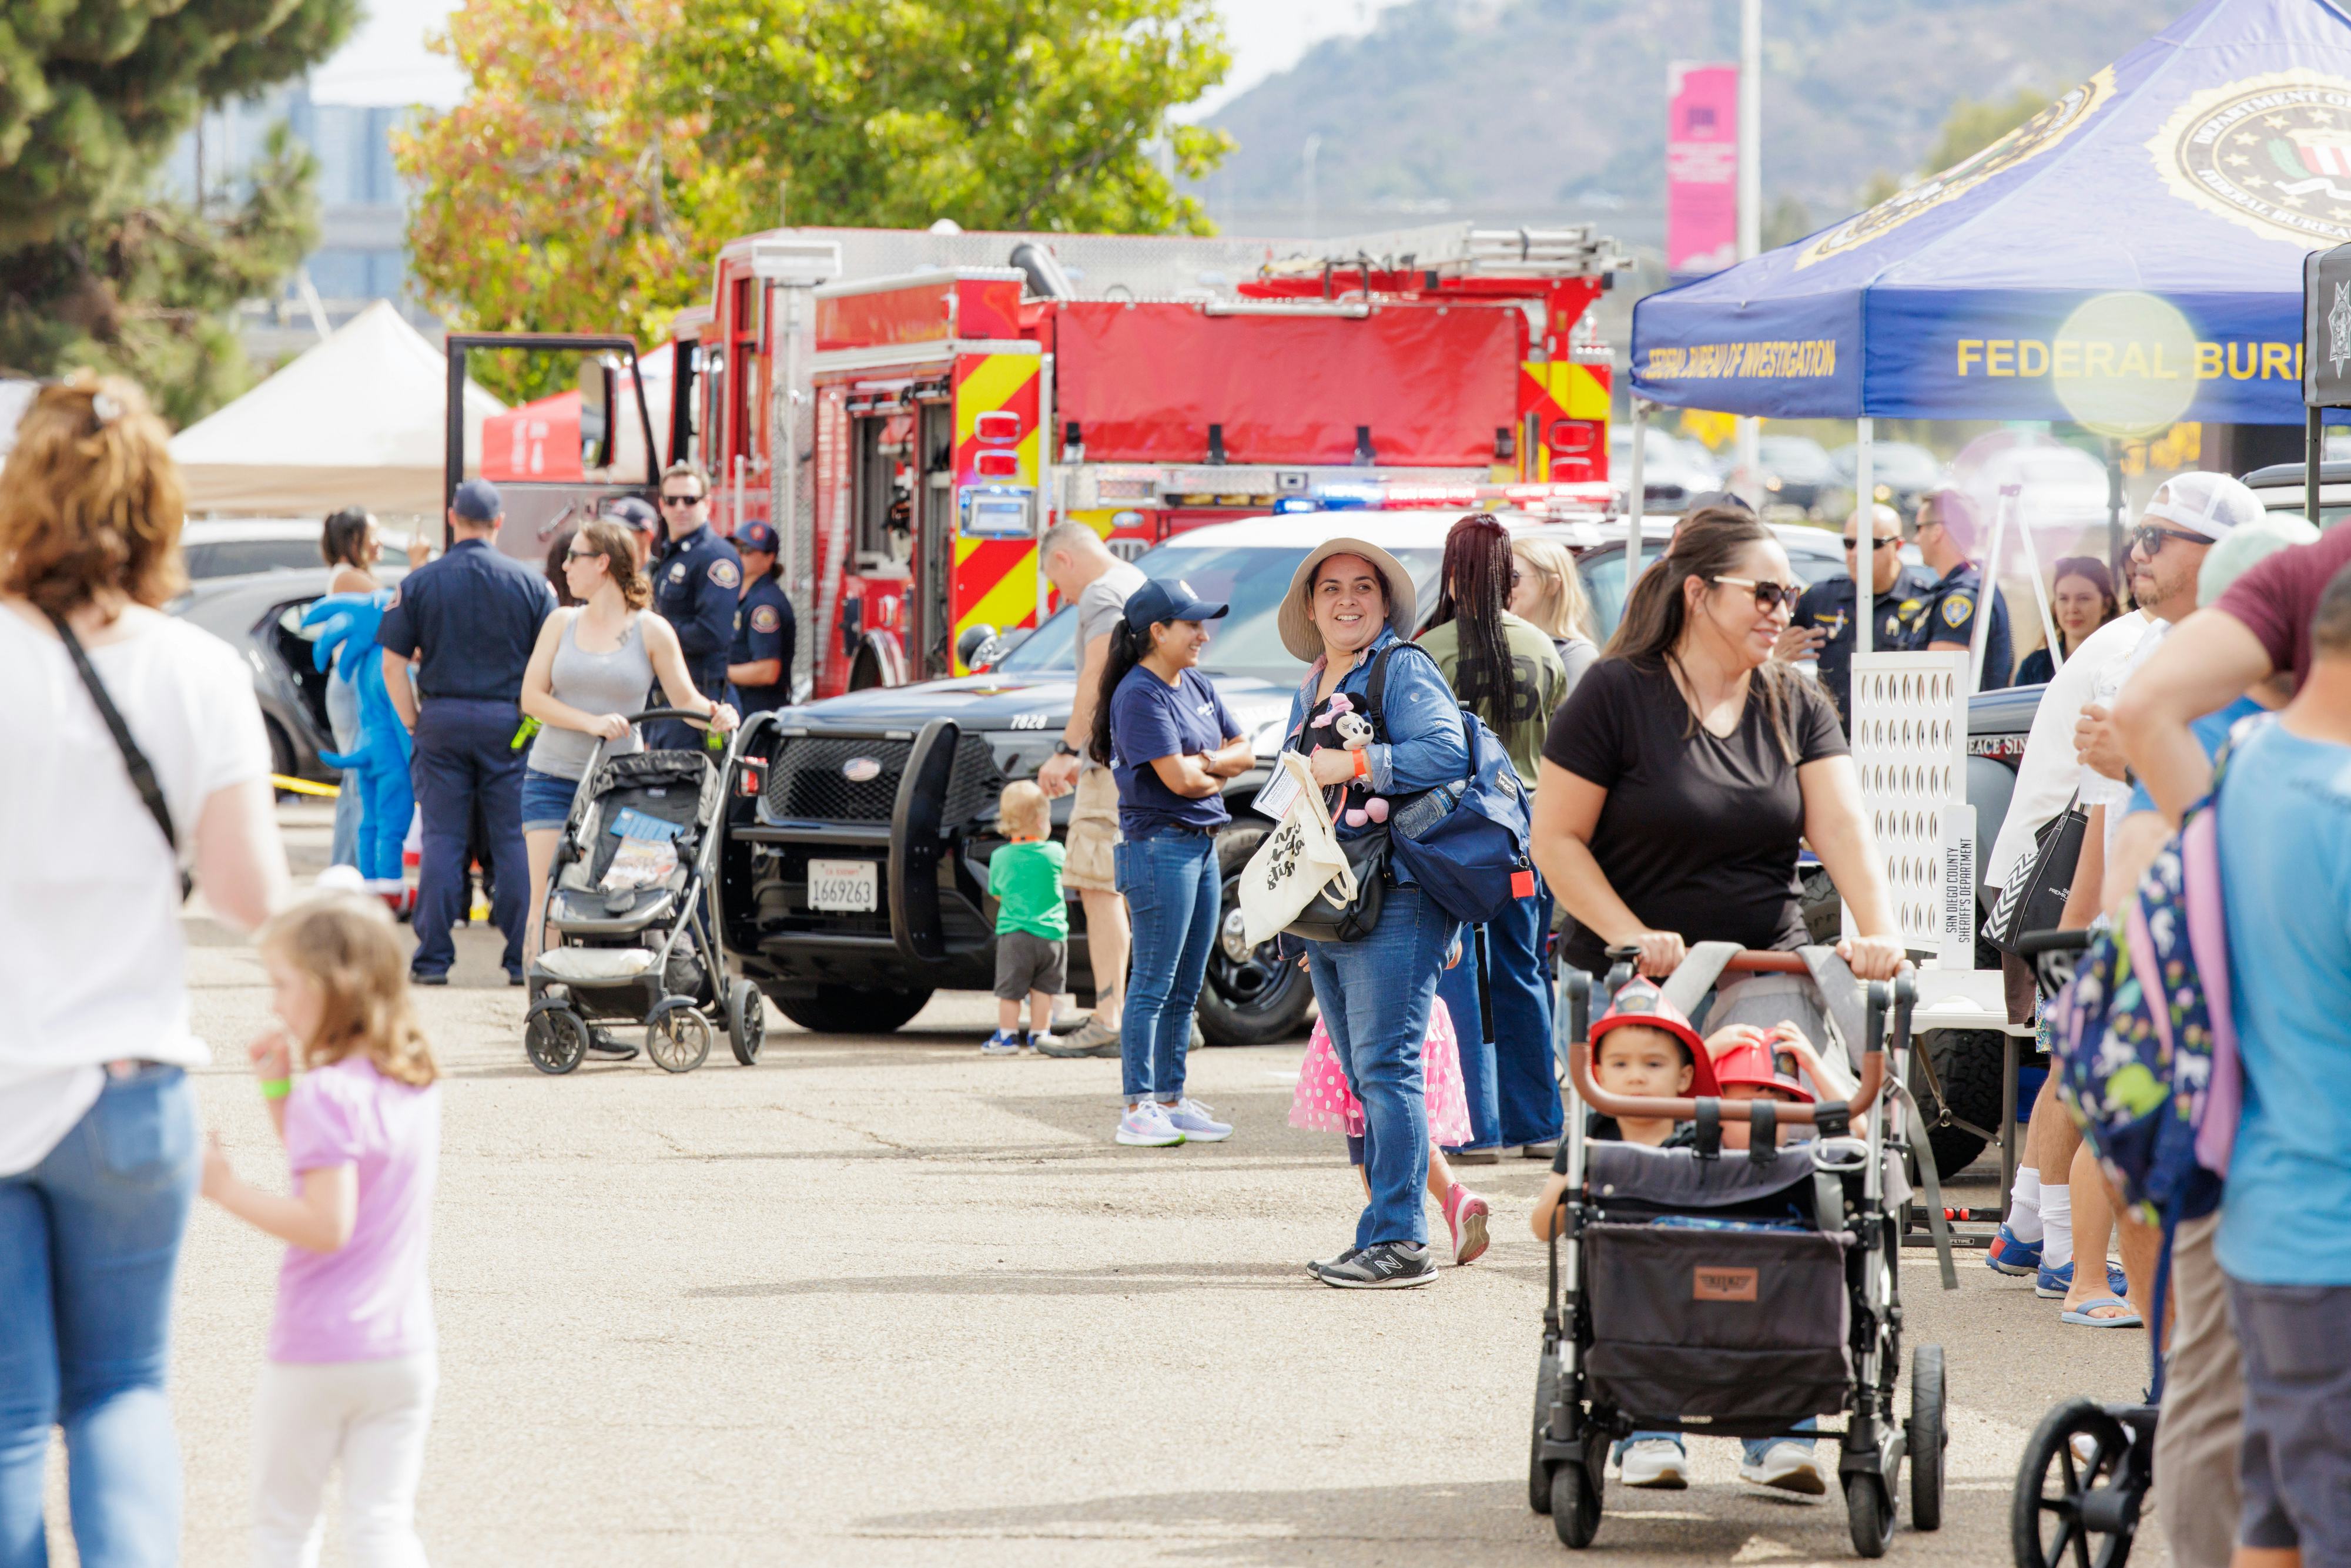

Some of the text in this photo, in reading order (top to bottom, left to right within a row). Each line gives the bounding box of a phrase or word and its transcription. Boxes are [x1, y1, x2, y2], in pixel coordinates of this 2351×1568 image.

[1737, 339, 1836, 378] INVESTIGATION
[1957, 339, 2302, 381] FEDERAL BUR
[813, 879, 870, 903] 1669263
[1946, 847, 1959, 933] SAN DIEGO COUNTY
[1958, 837, 1972, 943] SHERIFF'S DEPARTMENT
